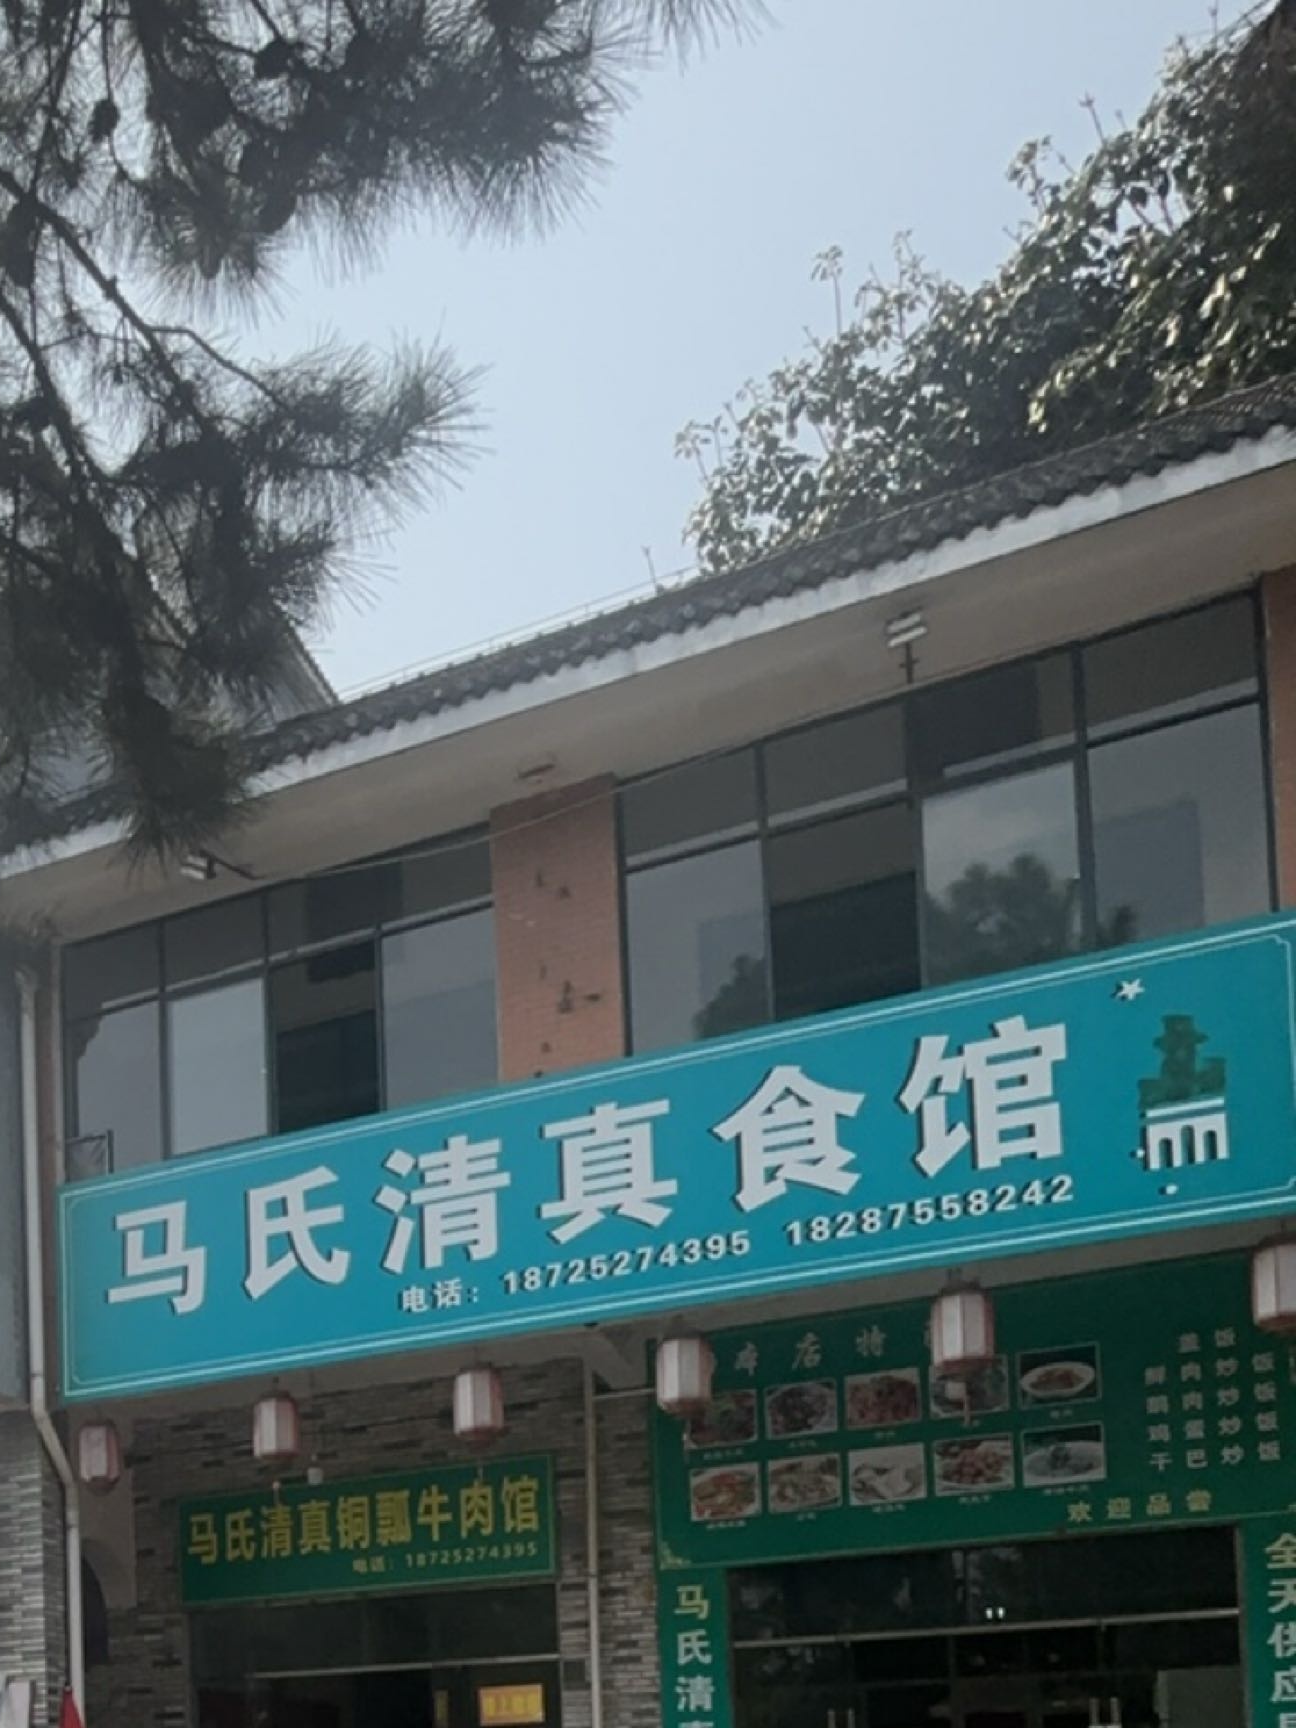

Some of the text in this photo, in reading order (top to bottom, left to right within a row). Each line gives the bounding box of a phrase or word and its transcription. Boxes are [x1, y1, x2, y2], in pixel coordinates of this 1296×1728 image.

[106, 1014, 1070, 1318] 马氏清真食馆
[784, 1174, 1075, 1249] 18287558242
[188, 1475, 540, 1565] 马氏清真铜瓢牛肉馆
